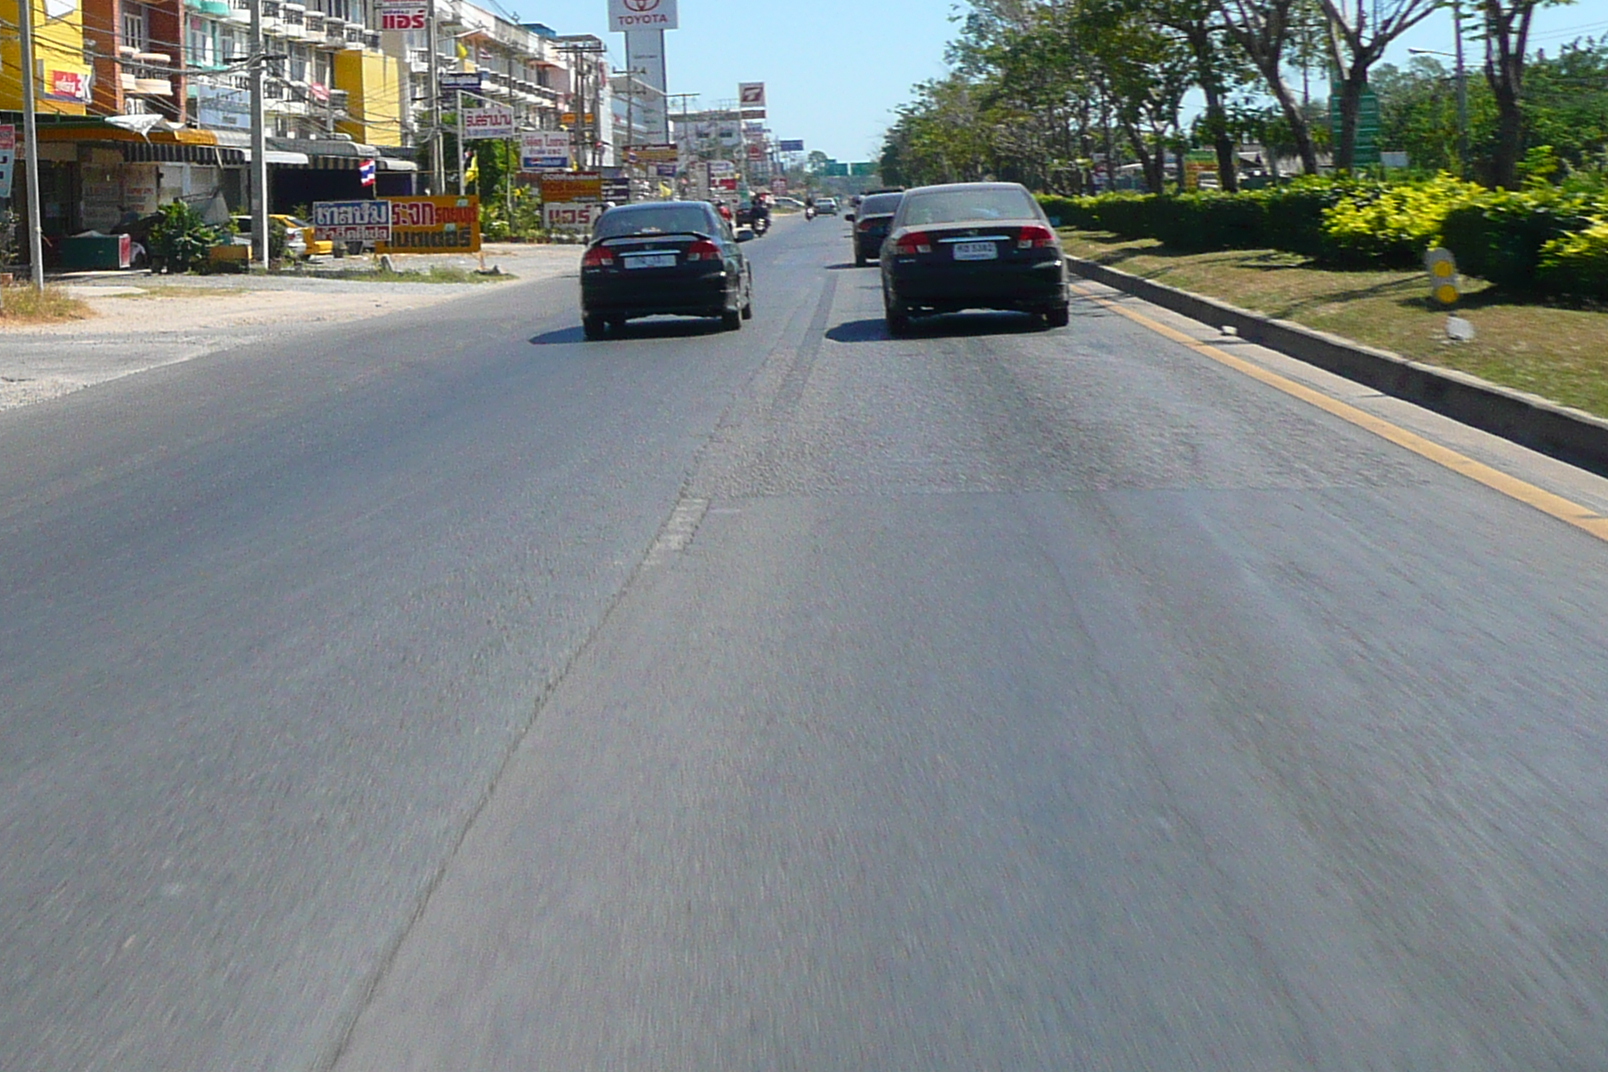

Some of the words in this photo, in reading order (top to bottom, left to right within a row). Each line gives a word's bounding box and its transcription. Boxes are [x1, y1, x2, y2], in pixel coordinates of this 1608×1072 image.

[382, 8, 426, 30] แอร์
[618, 13, 669, 27] TOYOTA
[548, 204, 592, 225] แอร์
